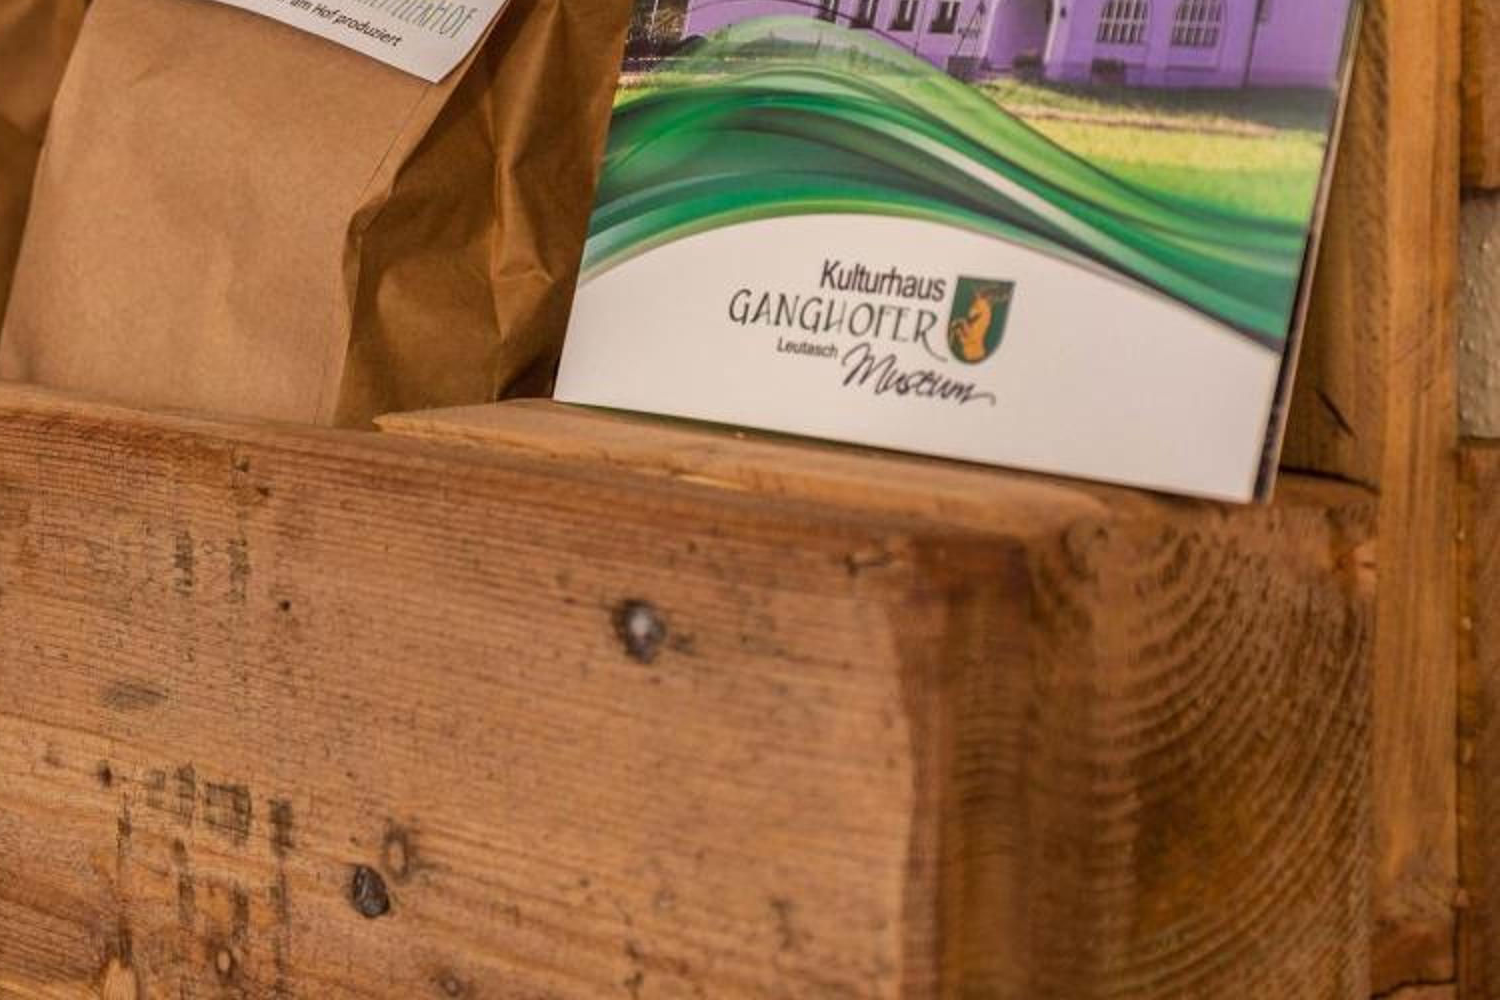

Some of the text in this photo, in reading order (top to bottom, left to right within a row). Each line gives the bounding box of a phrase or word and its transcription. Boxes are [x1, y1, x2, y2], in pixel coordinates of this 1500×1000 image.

[312, 3, 339, 19] Hof
[332, 14, 402, 46] produziert
[819, 258, 947, 301] Kulturhaus
[729, 288, 948, 362] GANGHOFER
[777, 337, 838, 358] Leutasch
[841, 342, 996, 405] Museum
